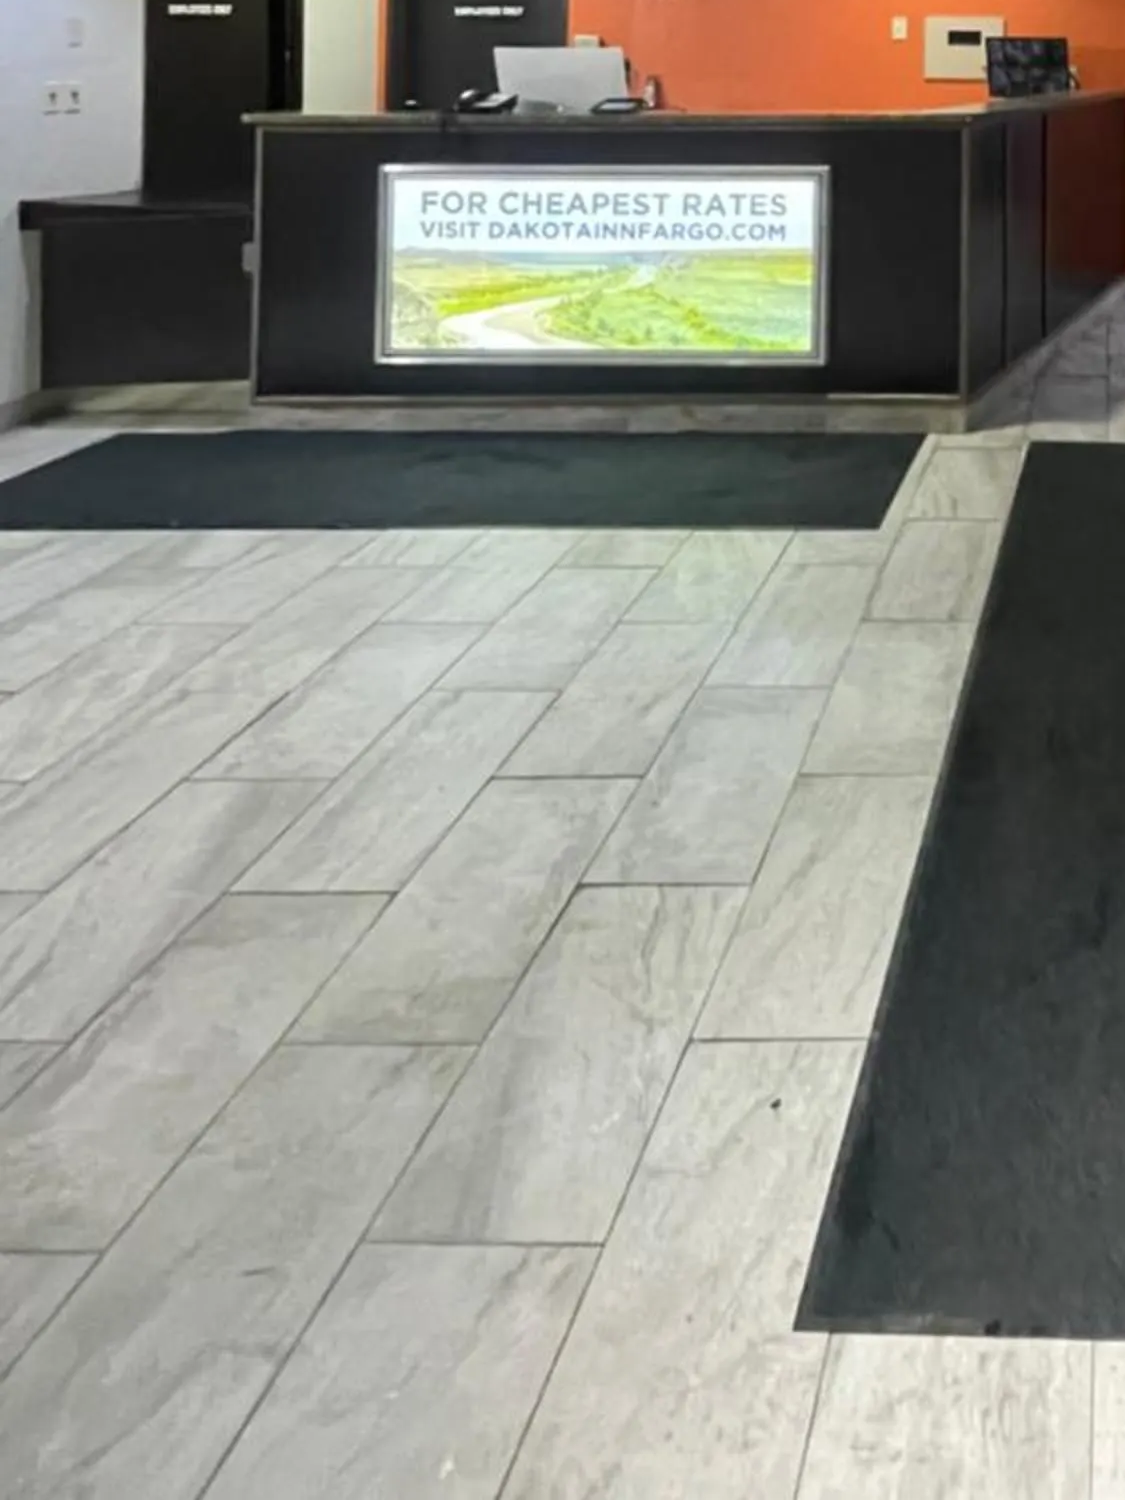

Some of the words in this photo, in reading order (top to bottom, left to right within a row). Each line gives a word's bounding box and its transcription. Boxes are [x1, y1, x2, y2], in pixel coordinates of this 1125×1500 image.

[421, 190, 487, 215] FOR
[499, 190, 671, 216] CHEAPEST
[682, 192, 787, 217] RATES
[420, 221, 481, 239] VISIT
[488, 221, 786, 241] DAKOTAINNFARGO.COM
